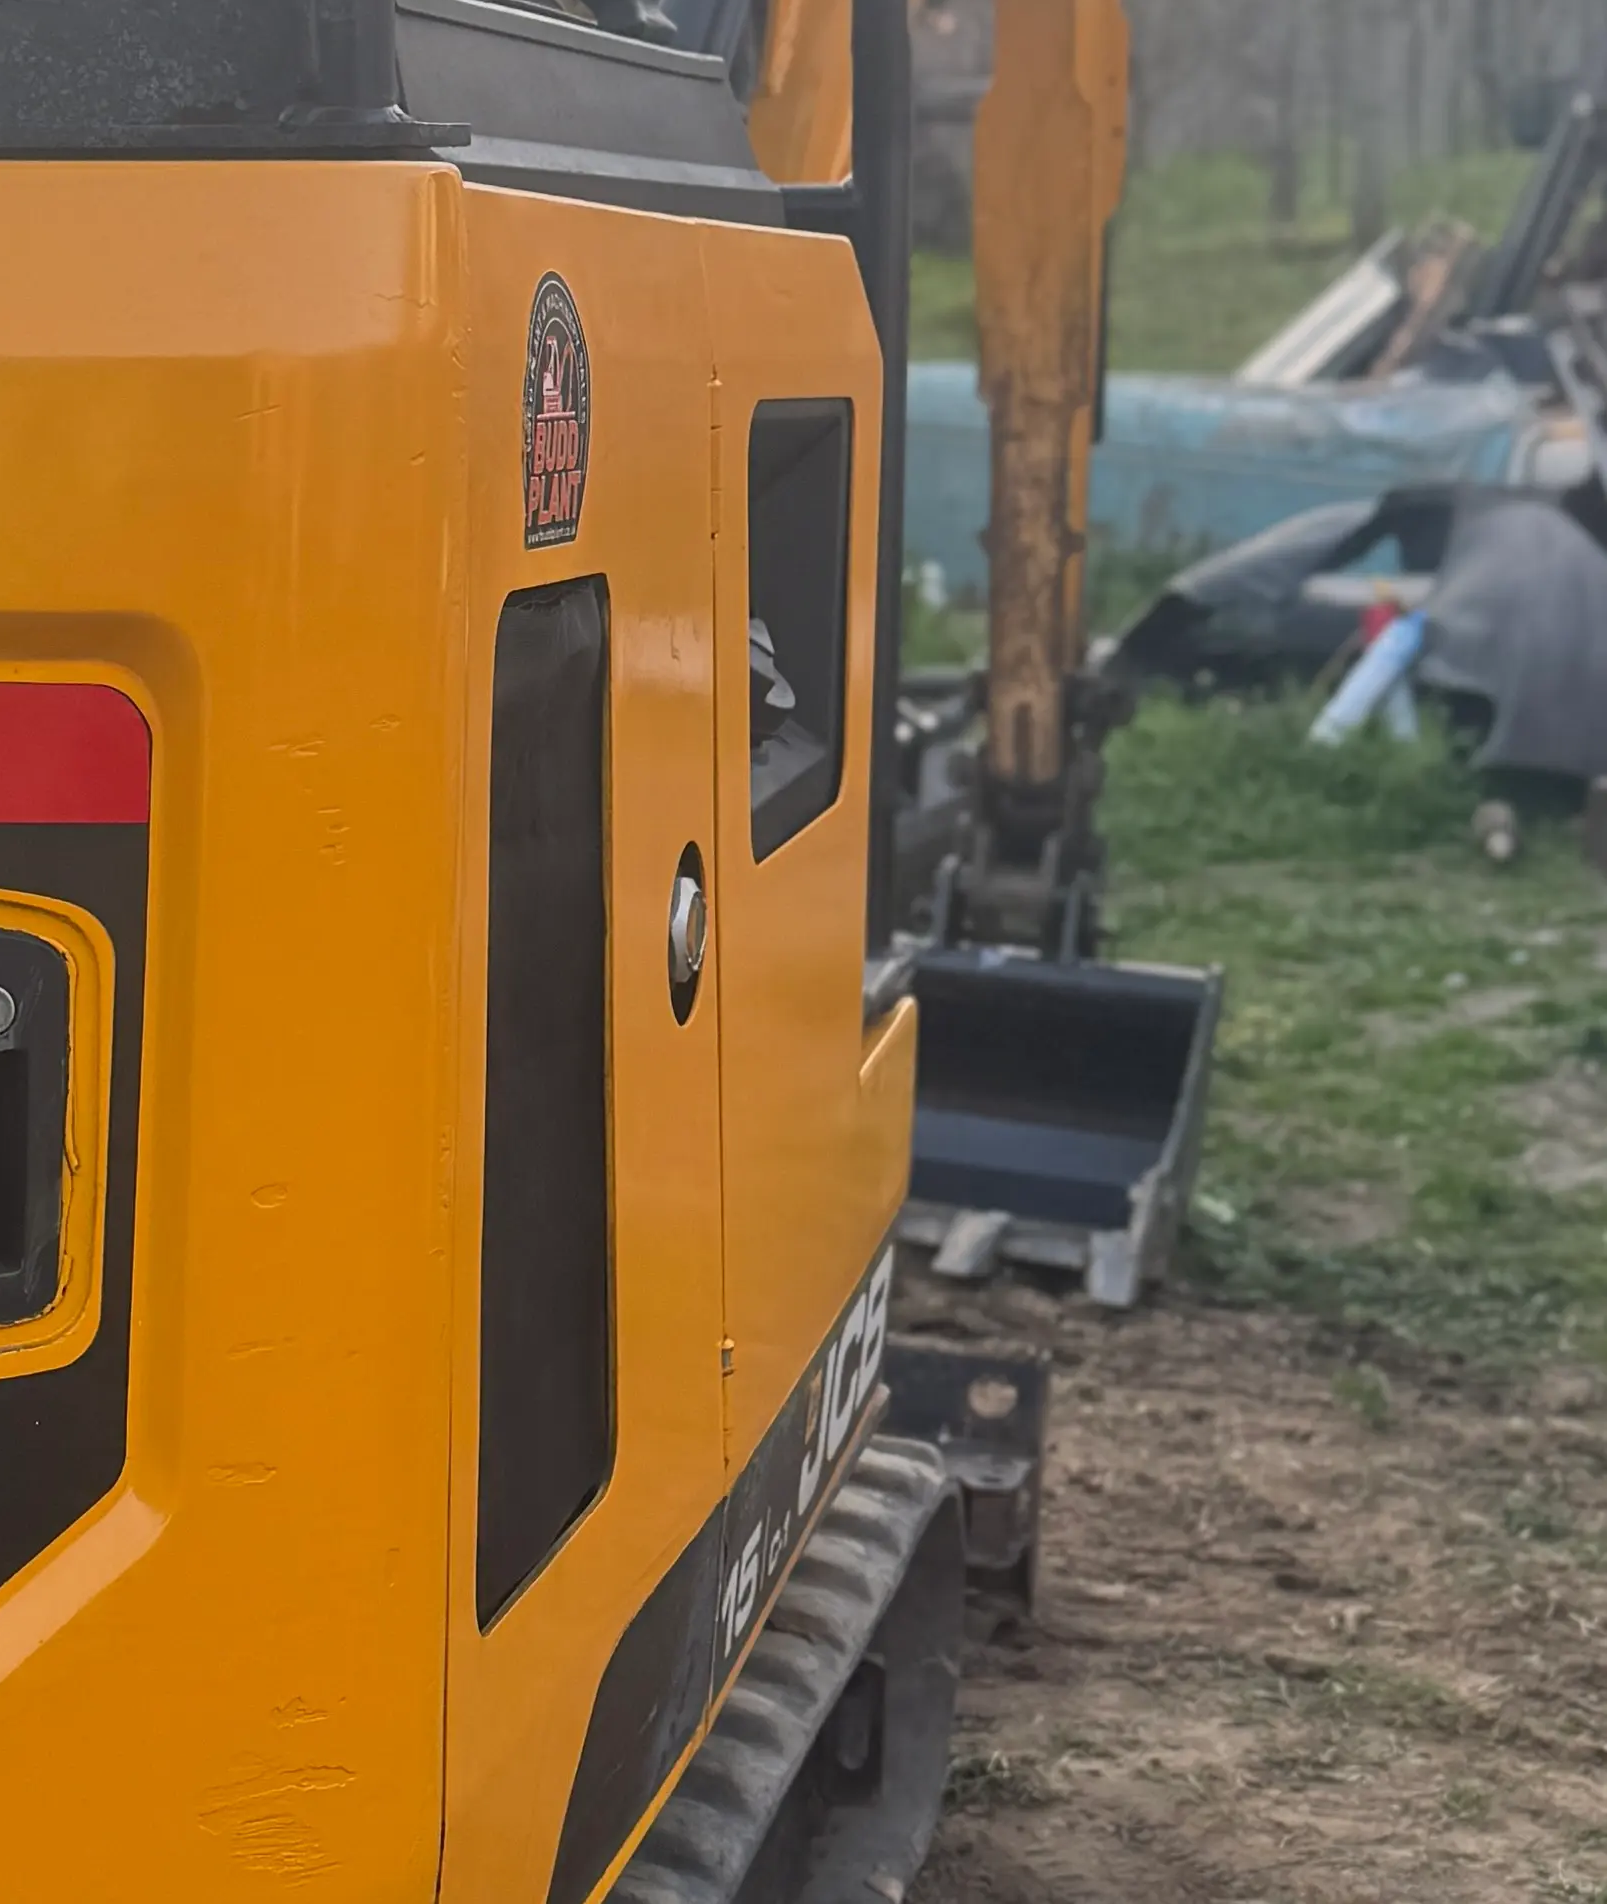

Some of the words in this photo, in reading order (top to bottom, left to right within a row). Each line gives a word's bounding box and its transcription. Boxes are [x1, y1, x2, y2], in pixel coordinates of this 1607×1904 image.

[534, 420, 579, 474] BUDD
[527, 470, 581, 527] PLANT
[797, 1244, 893, 1516] JCB
